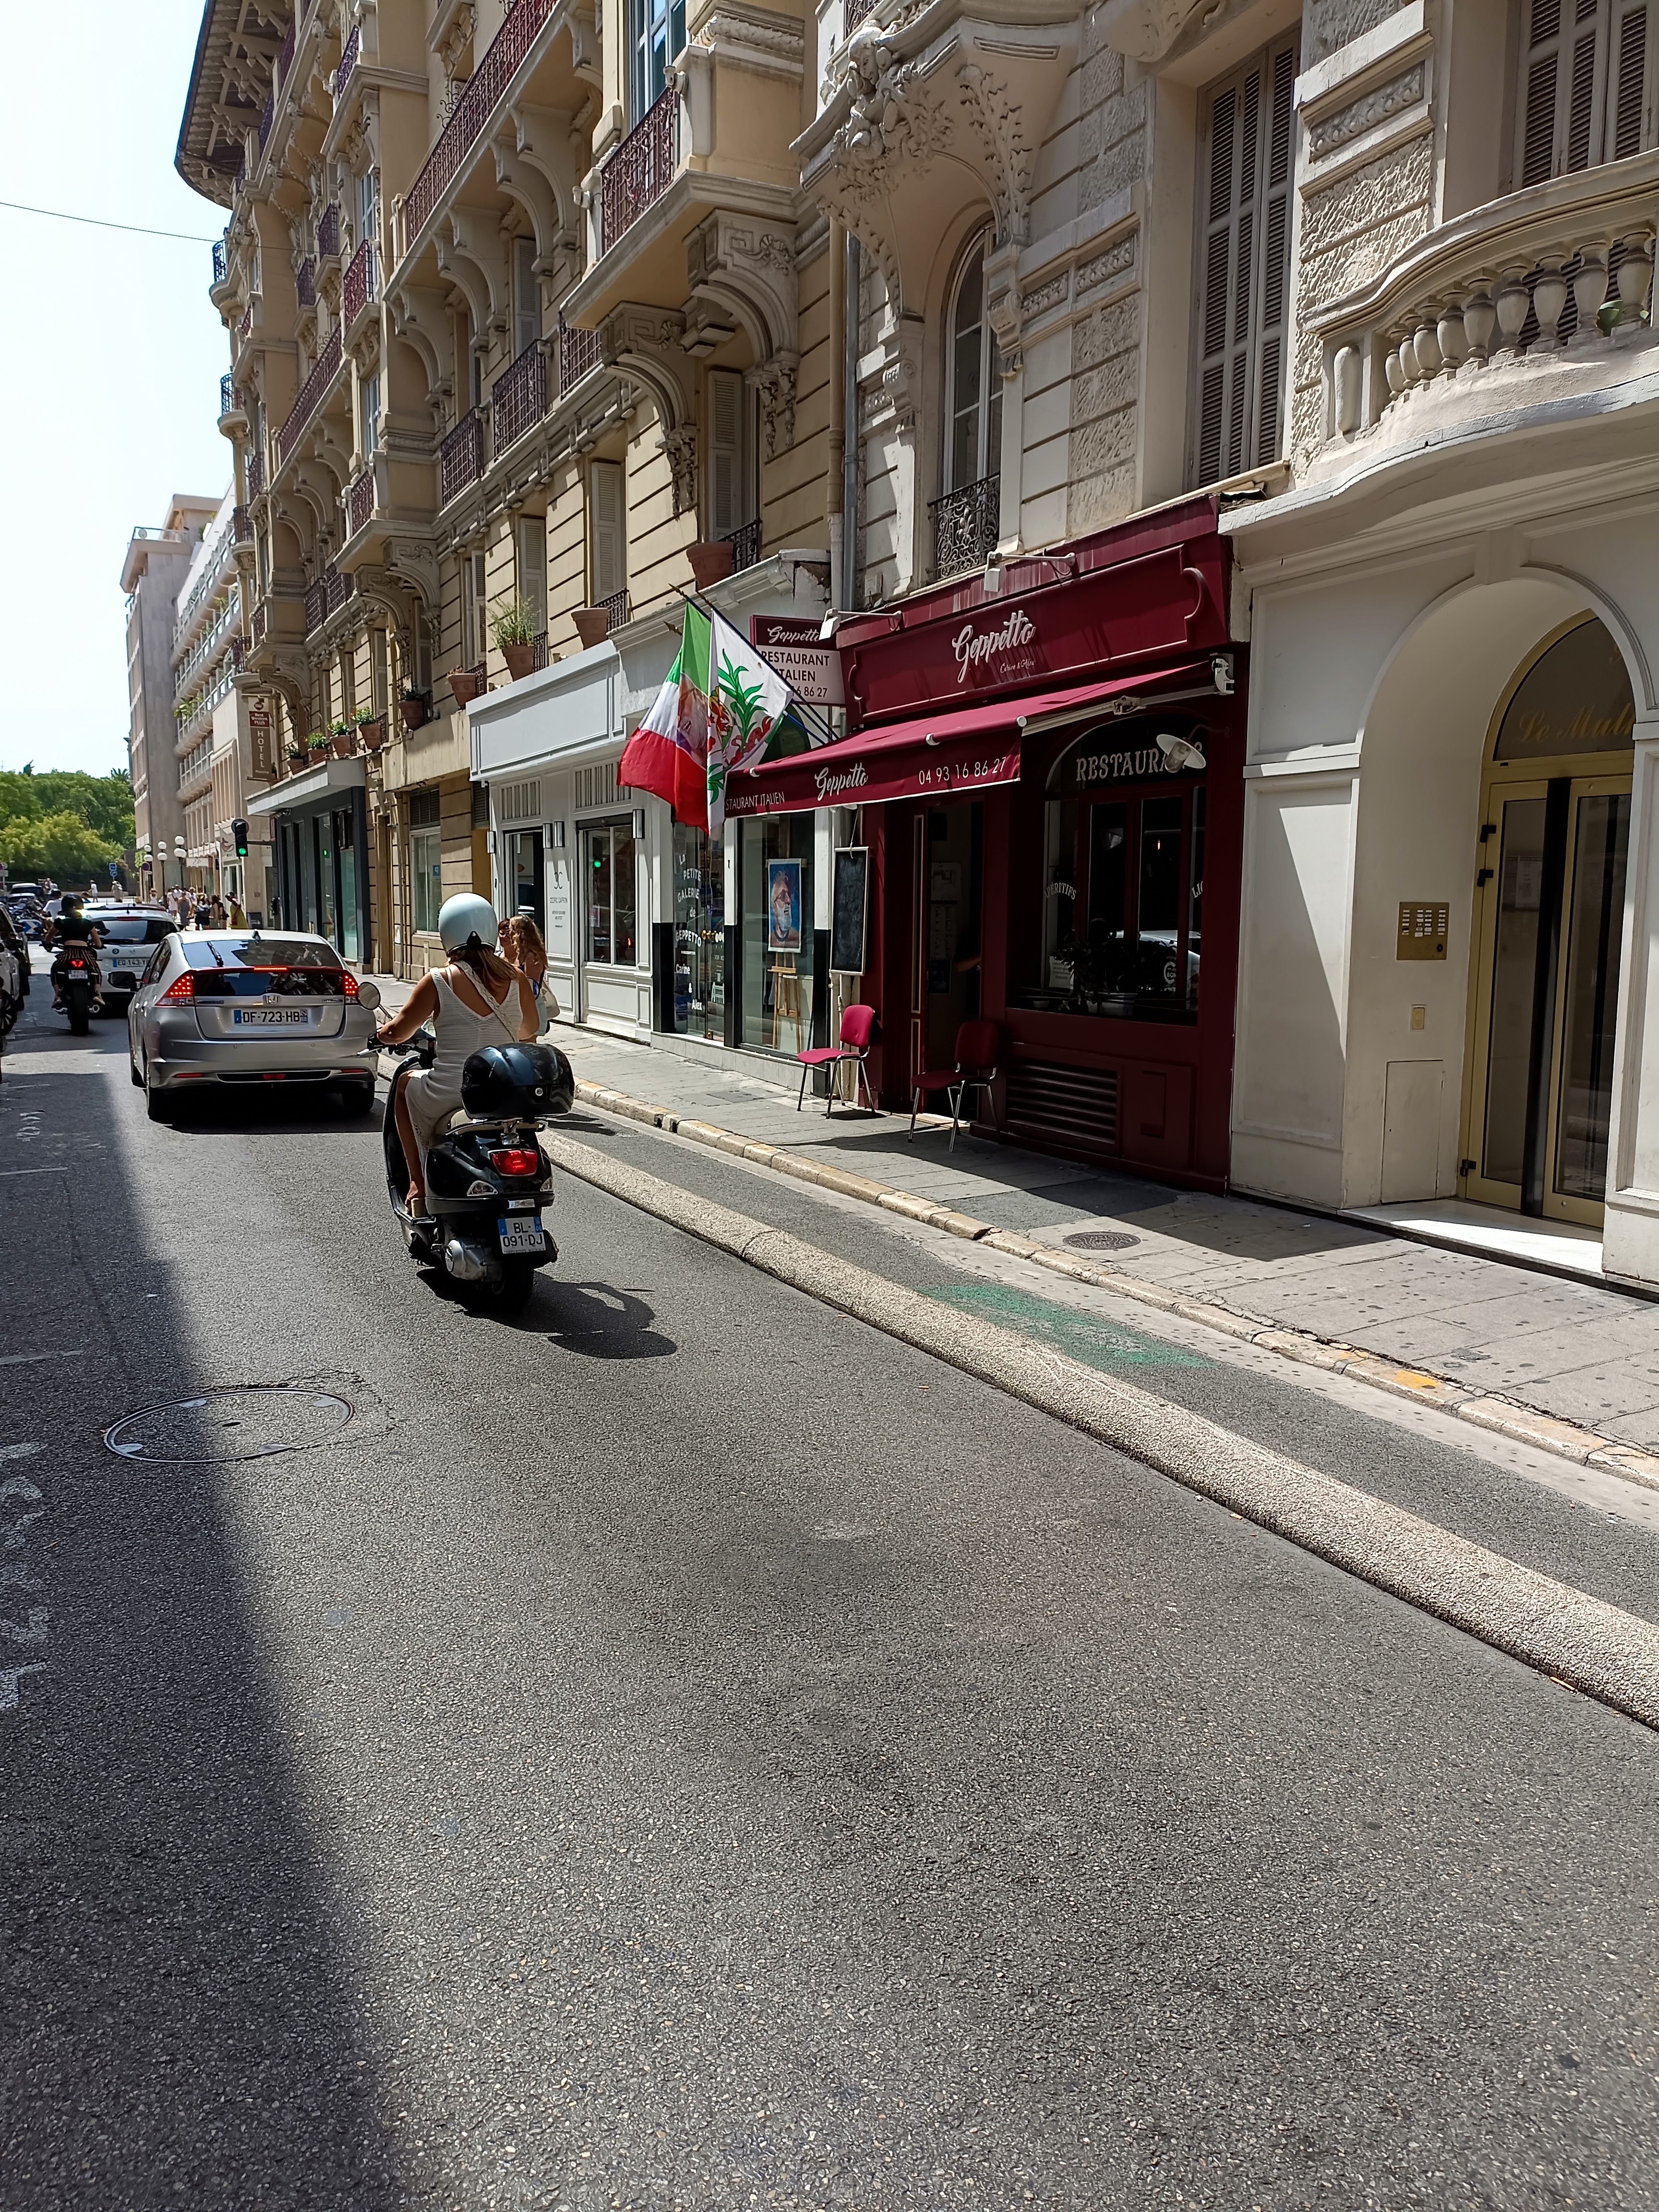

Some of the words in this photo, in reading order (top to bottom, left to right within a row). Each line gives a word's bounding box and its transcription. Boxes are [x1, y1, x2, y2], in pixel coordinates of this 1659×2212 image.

[951, 610, 1036, 683] Geppetto
[761, 651, 830, 666] RESTAURANT
[776, 668, 816, 682] TALIEN
[804, 686, 815, 697] 86
[817, 687, 828, 697] 27
[1076, 742, 1202, 781] RESTAURA
[919, 769, 931, 784] 04
[936, 766, 950, 782] 93
[955, 763, 969, 779] 16
[974, 760, 988, 777] 86
[992, 757, 1007, 774] 27
[815, 762, 868, 801] Geppetto
[726, 795, 758, 810] STAURANT
[760, 792, 785, 806] ITALIEN
[679, 854, 685, 865] La
[684, 868, 701, 881] PETITE
[677, 888, 699, 902] GALERIE
[690, 906, 696, 917] de
[675, 930, 701, 947] GEPPETTO
[676, 963, 690, 974] Carine
[688, 983, 692, 993] &
[692, 999, 702, 1010] Alex
[242, 1011, 300, 1023] DF-723-HB
[503, 1233, 543, 1247] 091-DJ
